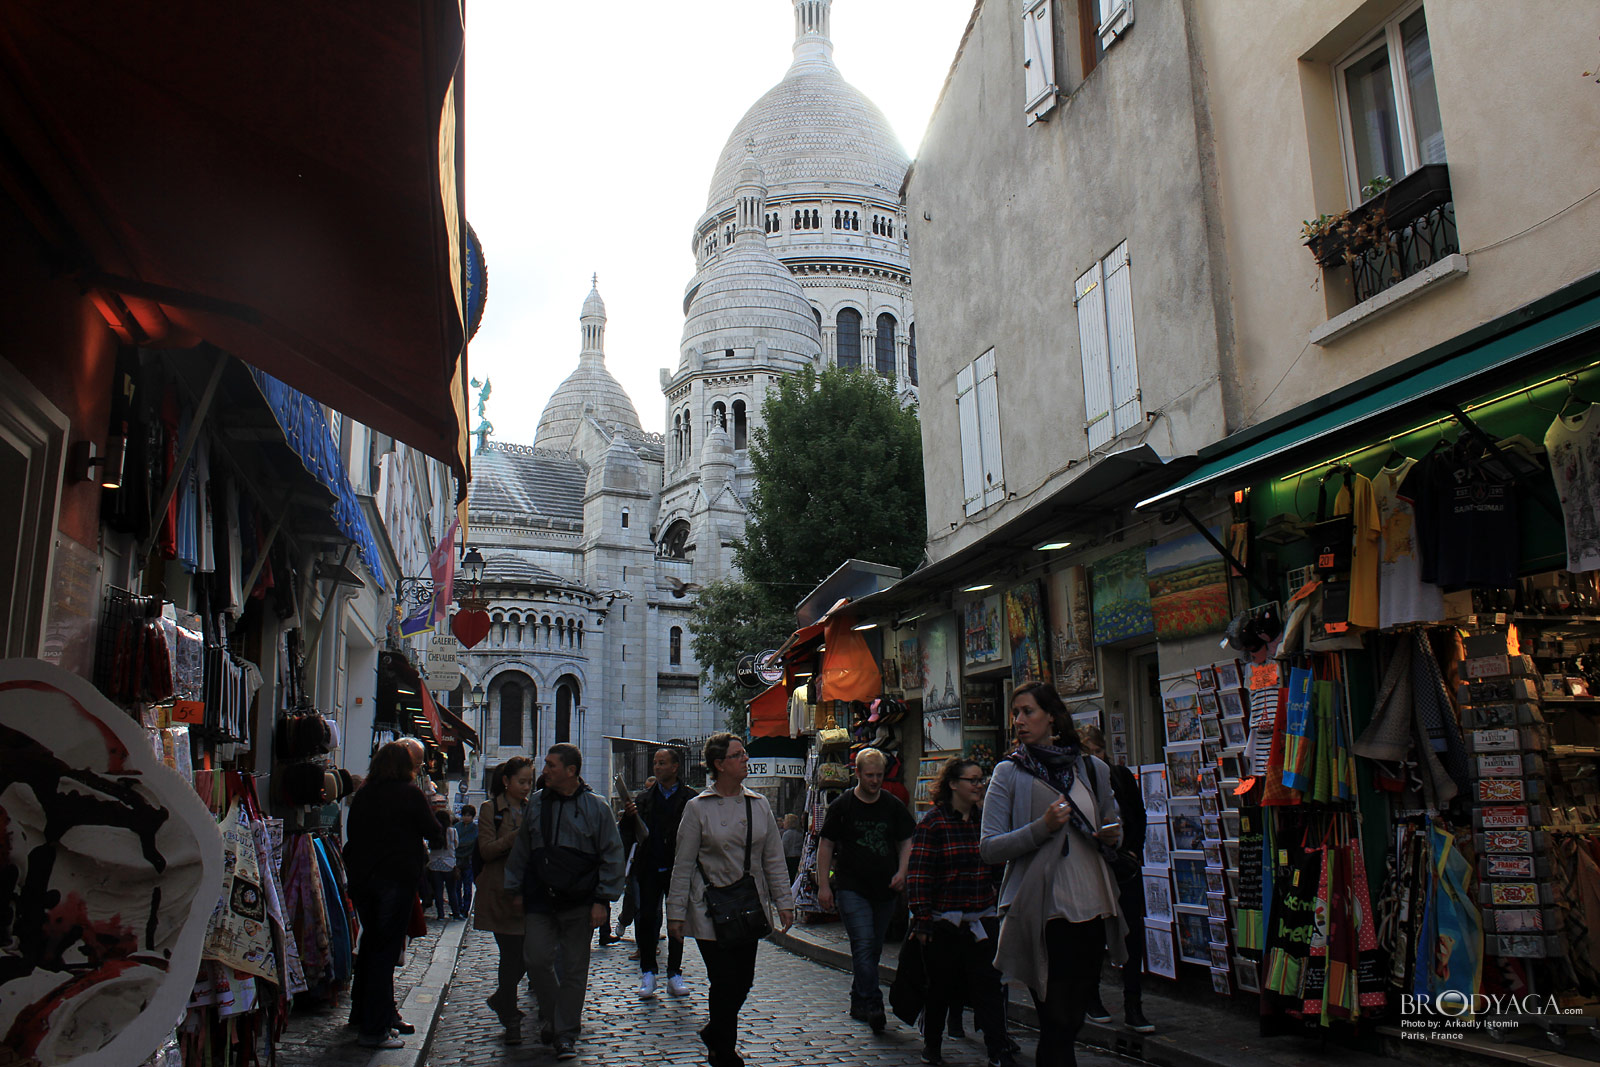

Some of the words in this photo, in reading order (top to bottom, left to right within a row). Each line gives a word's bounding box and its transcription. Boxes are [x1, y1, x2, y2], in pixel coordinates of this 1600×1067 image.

[432, 636, 457, 646] GALERIE
[428, 653, 456, 662] CHEVALIER
[747, 763, 767, 774] AFE
[776, 764, 787, 774] LA
[1493, 816, 1515, 824] PARIS
[1497, 861, 1520, 869] FRANCE
